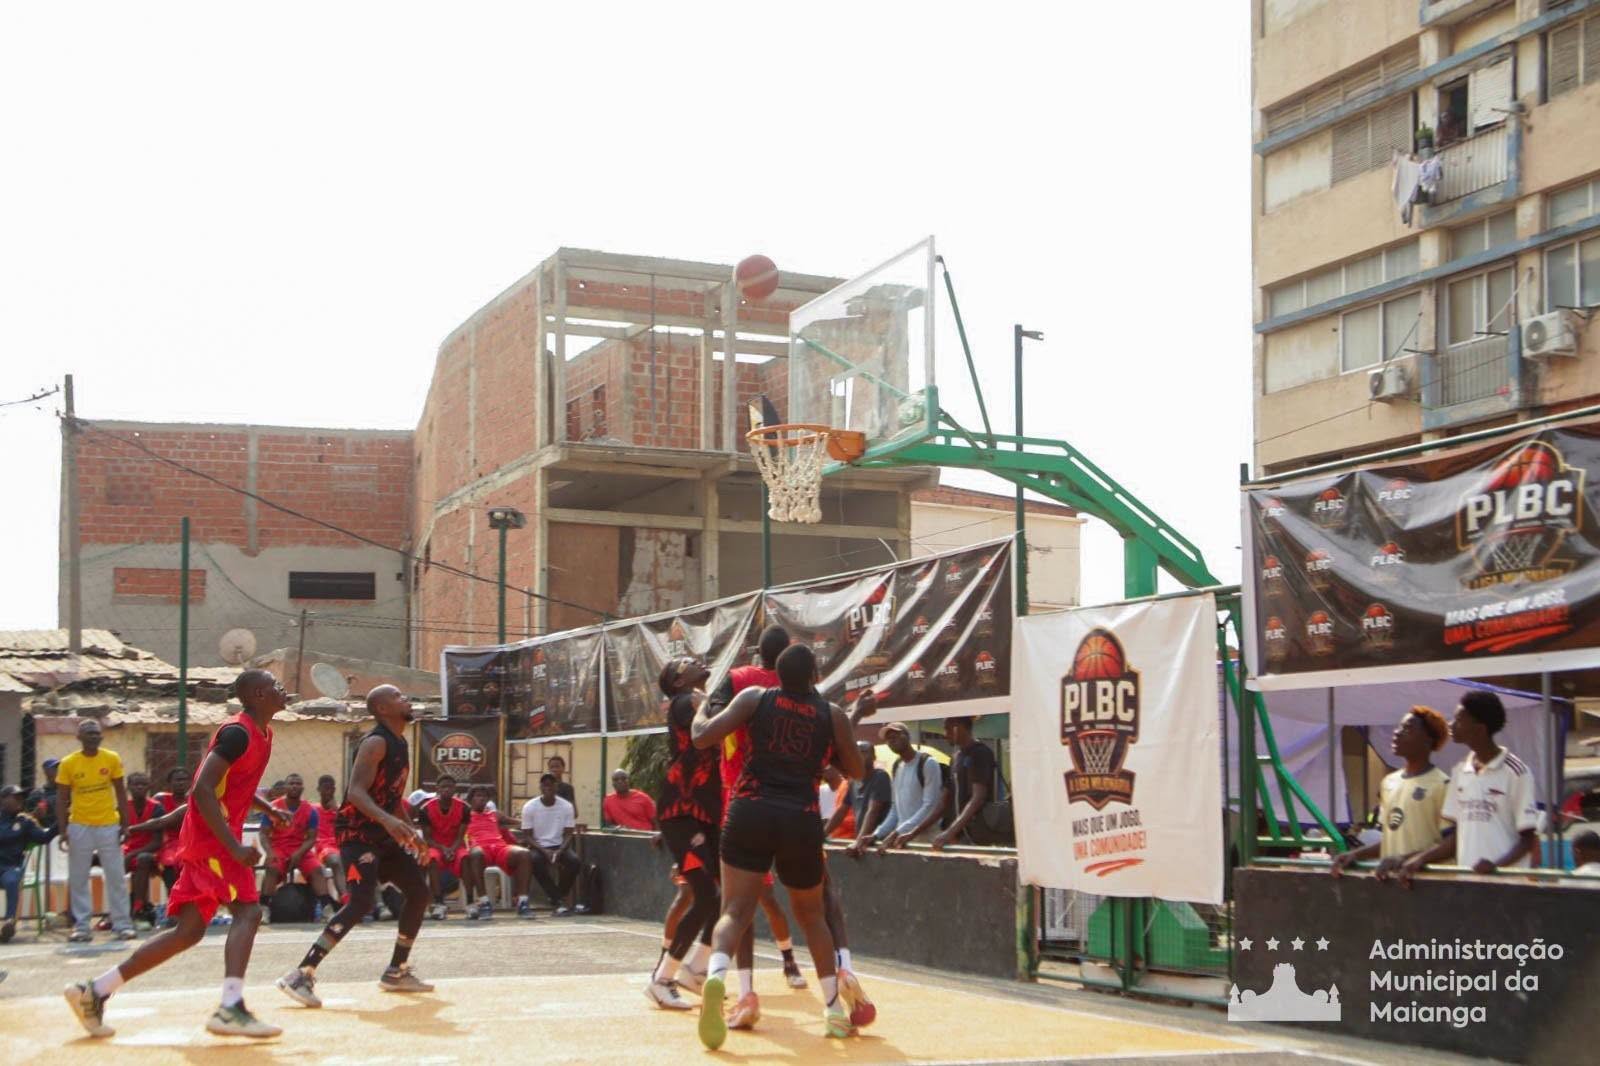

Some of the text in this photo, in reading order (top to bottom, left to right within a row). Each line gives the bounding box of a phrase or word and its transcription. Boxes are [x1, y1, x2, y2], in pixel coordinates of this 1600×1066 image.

[1314, 499, 1345, 512] PLBC
[1466, 479, 1574, 532] PLBC
[1371, 553, 1404, 567] PLBC
[1263, 566, 1282, 580] PLBC
[1308, 622, 1333, 636] PLBC
[1362, 615, 1393, 630] PLBC
[1265, 628, 1286, 641] PLBC
[1064, 680, 1136, 724] PLBC
[437, 747, 482, 762] PLBC
[1072, 818, 1089, 837] MAIS
[1090, 815, 1104, 834] QUE
[1105, 812, 1118, 831] UM
